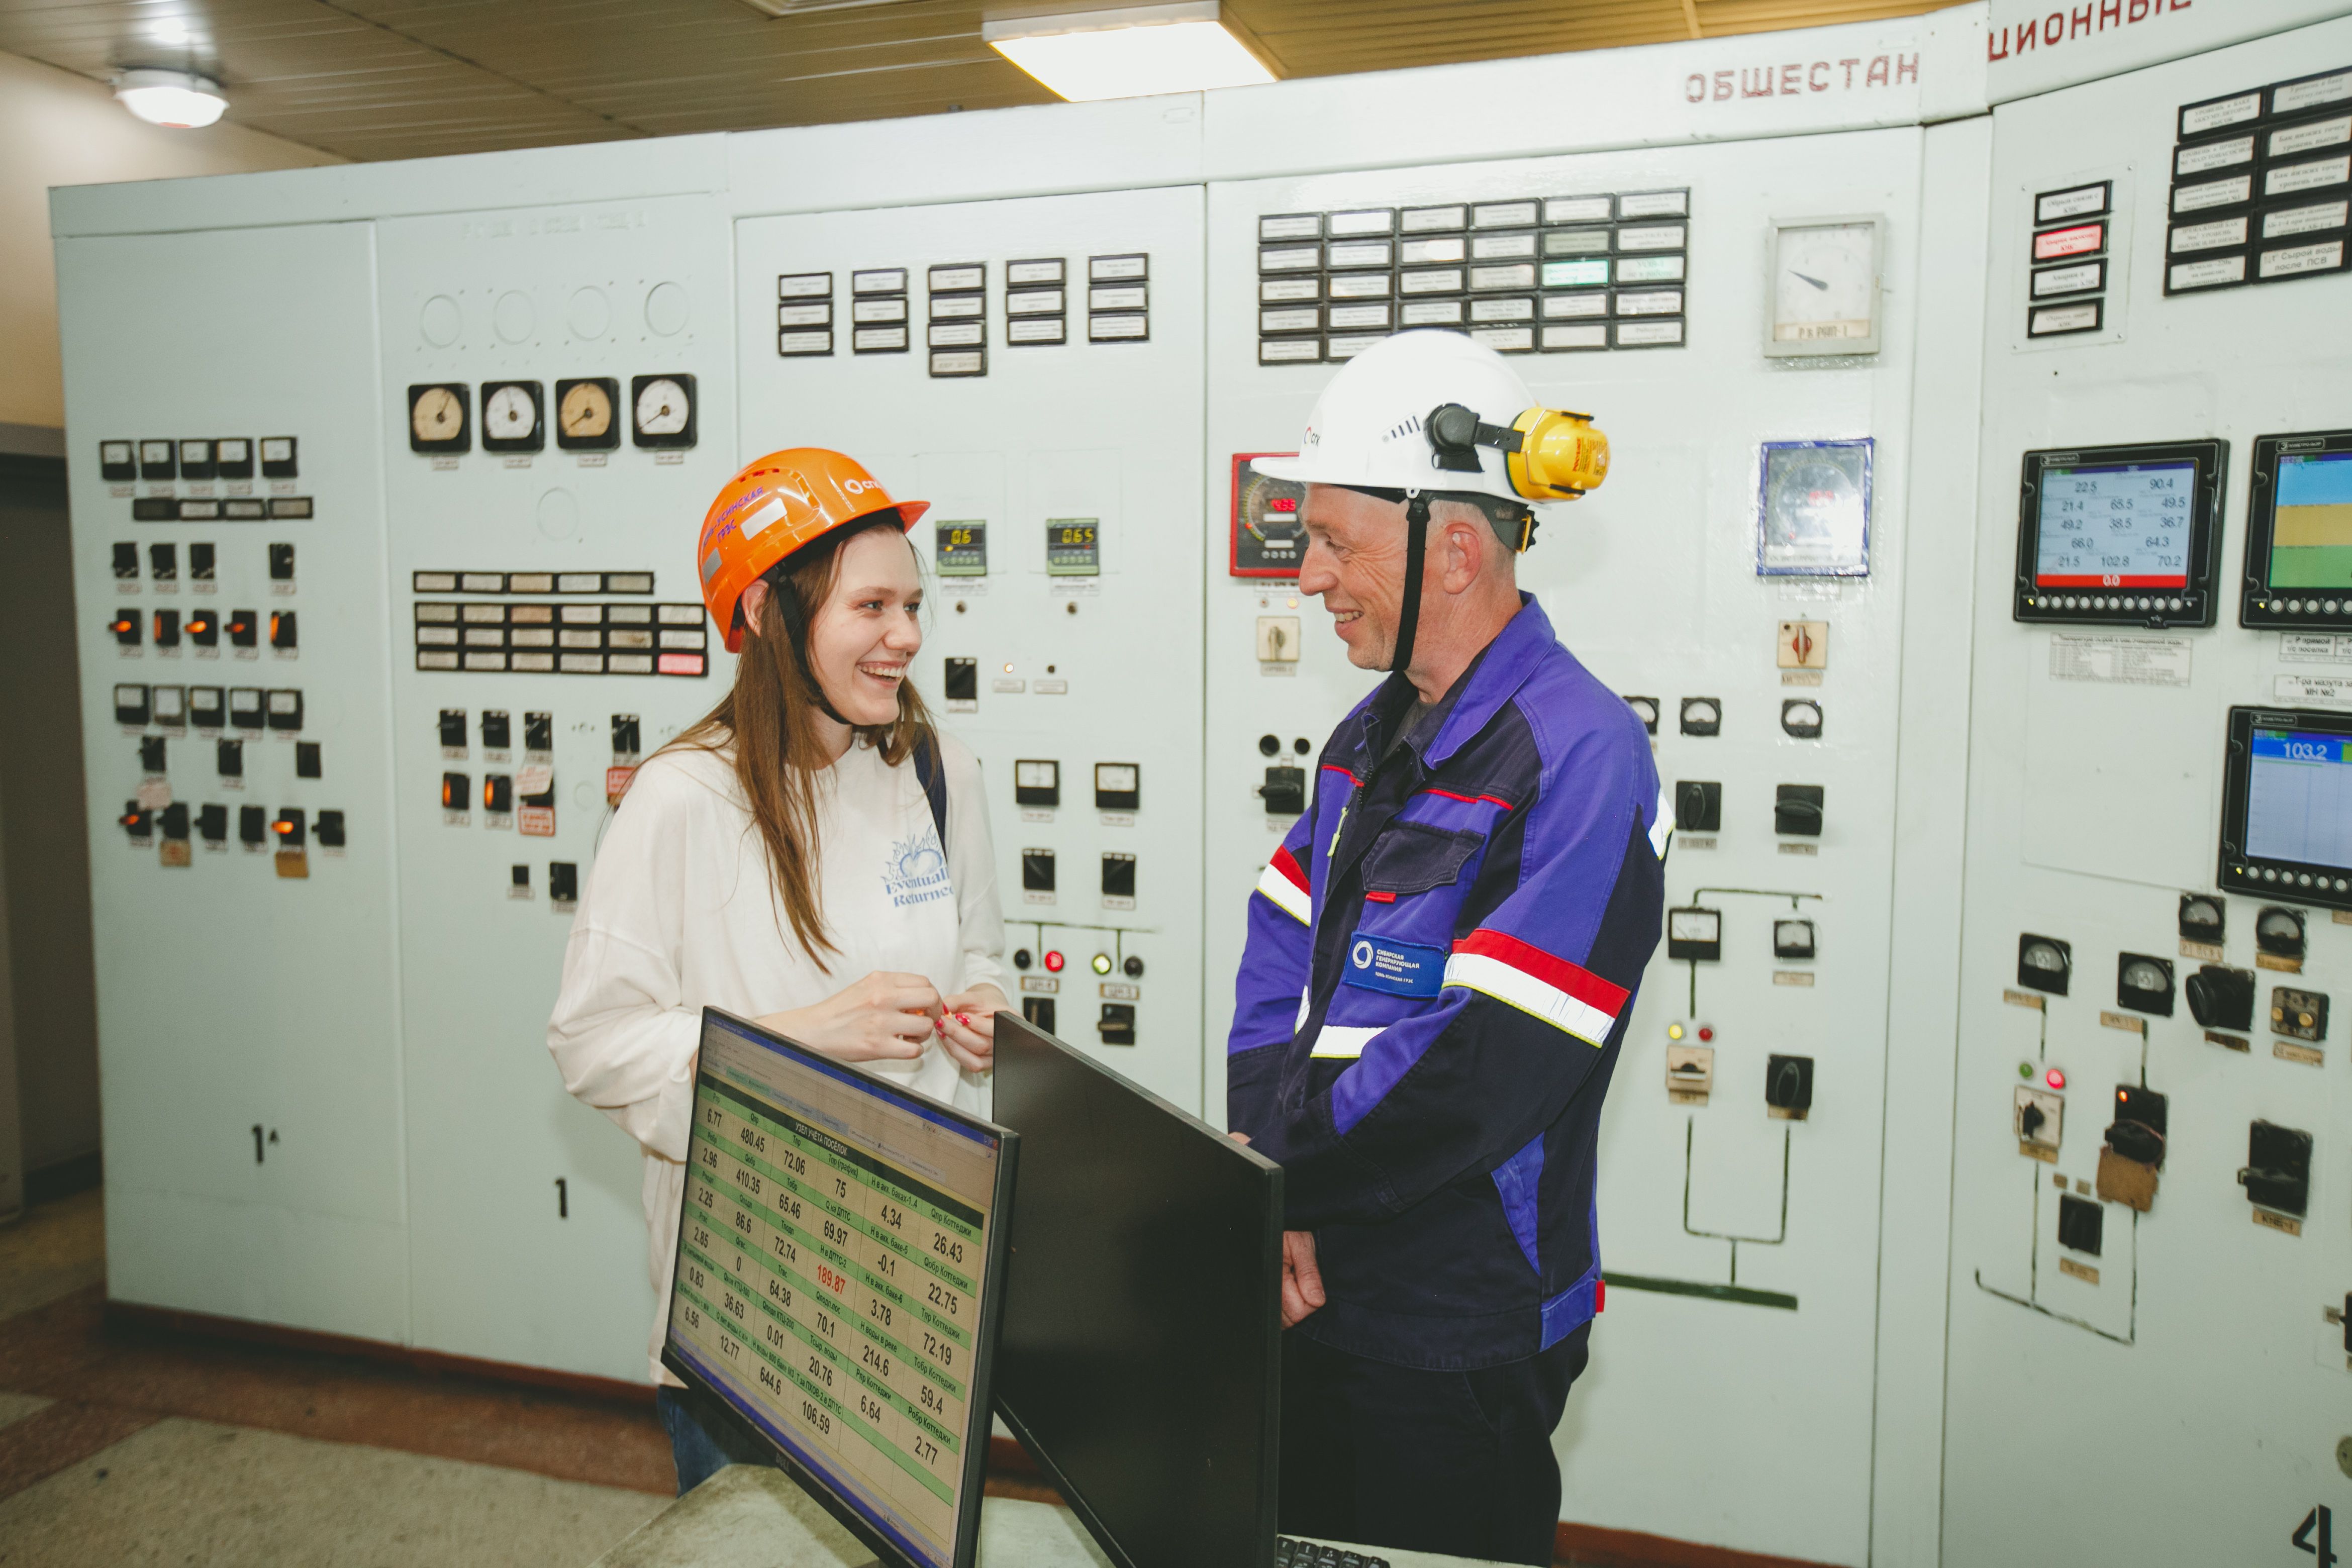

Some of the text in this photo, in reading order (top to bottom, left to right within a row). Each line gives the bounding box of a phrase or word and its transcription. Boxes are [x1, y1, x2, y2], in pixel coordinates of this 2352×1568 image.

[1988, 0, 2192, 63] ЦИОННЫ
[2274, 256, 2328, 272] после ПСВ
[2074, 480, 2098, 493] 22.5
[2149, 477, 2174, 490] 90.4
[2062, 501, 2084, 512] 21.4
[2162, 496, 2186, 509] 49.5
[717, 518, 737, 543] ГРЭС
[2160, 516, 2185, 528] 36.7
[2145, 536, 2170, 548] 64.3
[2157, 555, 2182, 567] 70.2
[2102, 573, 2121, 587] 0.0
[2302, 636, 2331, 645] прямой
[2314, 677, 2342, 688] мазута
[1376, 956, 1420, 969] ГЕНЕРИРУЮЩАЯ
[1377, 949, 1404, 960] СИБИРСКАЯ
[1375, 962, 1402, 973] КОМПАНИЯ
[708, 1108, 722, 1128] 6.77
[750, 1113, 759, 1124] Qпр
[741, 1127, 765, 1153] 480.45
[793, 1135, 801, 1147] Тпр
[796, 1122, 848, 1156] УЗЕЛ УЧЁТА ПОСЁЛОК
[703, 1147, 718, 1168] 2.96
[745, 1153, 756, 1166] Qобр
[785, 1150, 805, 1175] 72.06
[829, 1153, 859, 1179] Тпр (график)
[736, 1168, 760, 1195] 410.35
[787, 1178, 798, 1192] Тобр
[836, 1178, 846, 1199] 75
[871, 1177, 876, 1186] Н
[880, 1183, 891, 1196] акк.
[892, 1187, 918, 1208] баках-1..4
[554, 1177, 568, 1220] 1
[699, 1188, 714, 1208] 2.25
[779, 1194, 801, 1219] 65.46
[736, 1211, 752, 1234] 86.6
[826, 1200, 851, 1222] Q на ДПТС
[881, 1204, 902, 1230] 4.34
[931, 1208, 971, 1238] Qпр Коттеджи
[694, 1227, 709, 1248] 2.85
[781, 1220, 795, 1235] Тподп
[824, 1220, 848, 1247] 69.97
[870, 1225, 875, 1235] Н
[880, 1232, 890, 1244] акк.
[891, 1237, 908, 1255] баке-5
[774, 1236, 796, 1263] 72.74
[820, 1244, 825, 1253] Н
[828, 1249, 847, 1268] ДПТС-2
[933, 1232, 962, 1263] 26.43
[736, 1256, 741, 1271] 0
[778, 1264, 788, 1278] Тгвс
[877, 1254, 895, 1277] -0.1
[924, 1257, 968, 1291] Qобр Коттеджи
[690, 1266, 704, 1289] 0.83
[817, 1264, 846, 1295] 189.87
[865, 1273, 903, 1304] Н в акк. баке-6
[725, 1292, 744, 1319] 36.63
[770, 1280, 791, 1307] 64.38
[928, 1283, 958, 1315] 22.75
[685, 1306, 700, 1329] 6.56
[817, 1312, 835, 1338] 70.1
[871, 1299, 892, 1326] 3.78
[921, 1307, 960, 1340] Тпр Коттеджи
[721, 1335, 740, 1360] 12.77
[767, 1325, 783, 1349] 0.01
[810, 1334, 838, 1361] Тсыр. воды
[860, 1321, 898, 1353] Н воды в реке
[923, 1332, 952, 1366] 72.19
[809, 1356, 833, 1387] 20.76
[863, 1345, 890, 1377] 214.6
[760, 1366, 782, 1395] 644.6
[856, 1368, 892, 1402] Рпр Коттеджи
[914, 1356, 956, 1393] Тобр Коттеджи
[796, 1373, 800, 1382] Т
[806, 1379, 824, 1399] ПХОВ-2
[828, 1397, 842, 1415] ДПТС
[921, 1385, 943, 1415] 59.4
[802, 1400, 830, 1435] 106.59
[860, 1395, 881, 1423] 6.64
[908, 1406, 951, 1445] Робр Коттеджи
[915, 1435, 938, 1465] 2.77
[2292, 1503, 2338, 1568] 4
